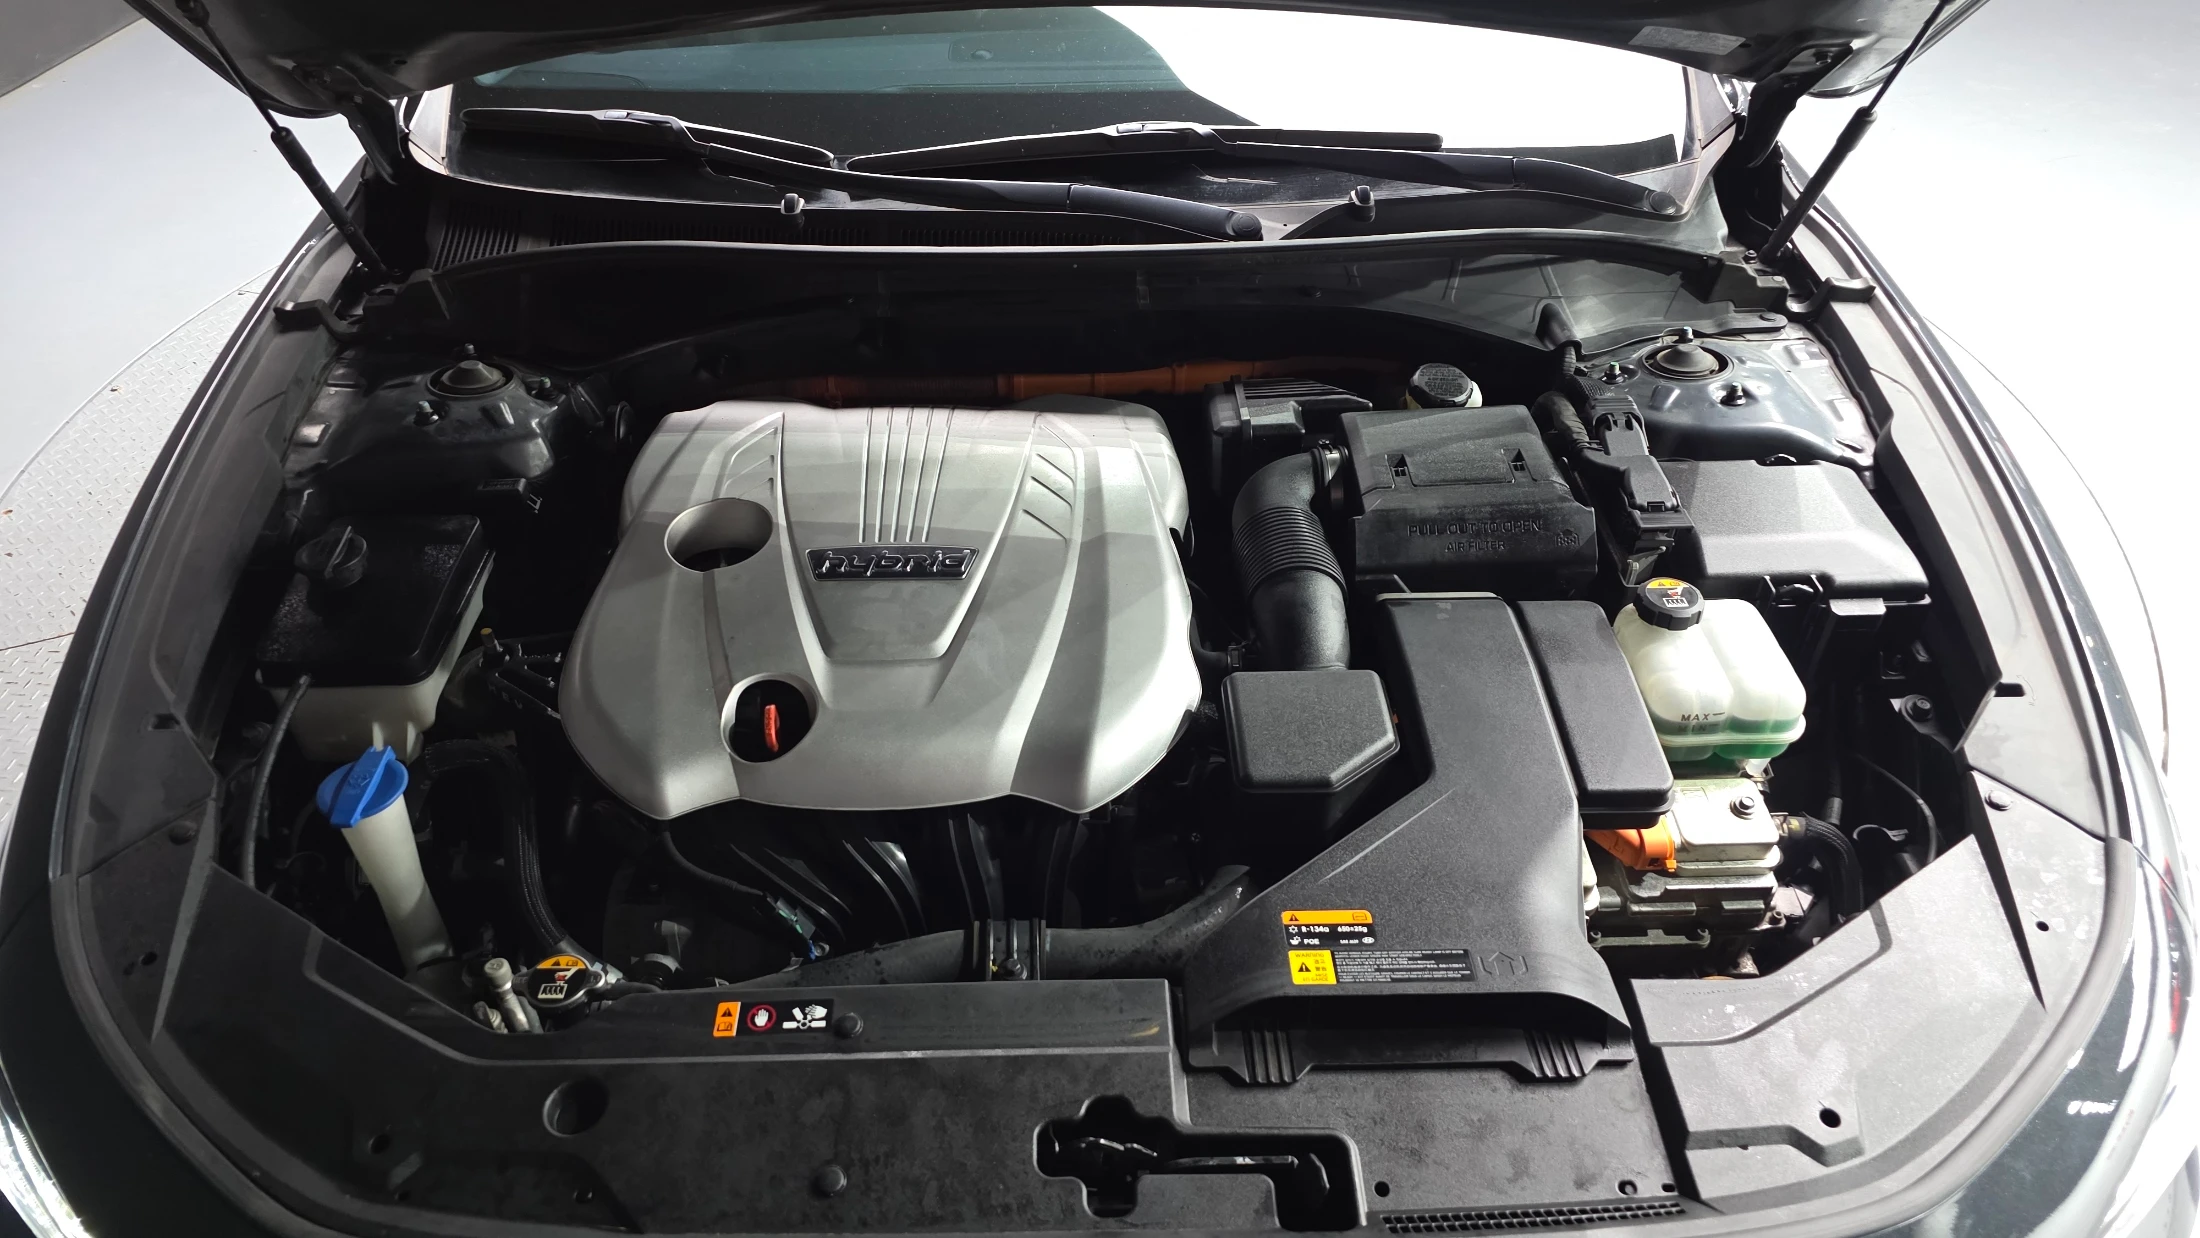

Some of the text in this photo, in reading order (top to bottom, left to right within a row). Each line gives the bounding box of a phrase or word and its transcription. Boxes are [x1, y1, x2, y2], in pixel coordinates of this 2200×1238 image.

[1407, 519, 1541, 537] PULL OUT TO OPEN
[1445, 539, 1505, 552] AIR FILTER
[815, 550, 971, 577] hybrid
[1681, 713, 1710, 721] MAX
